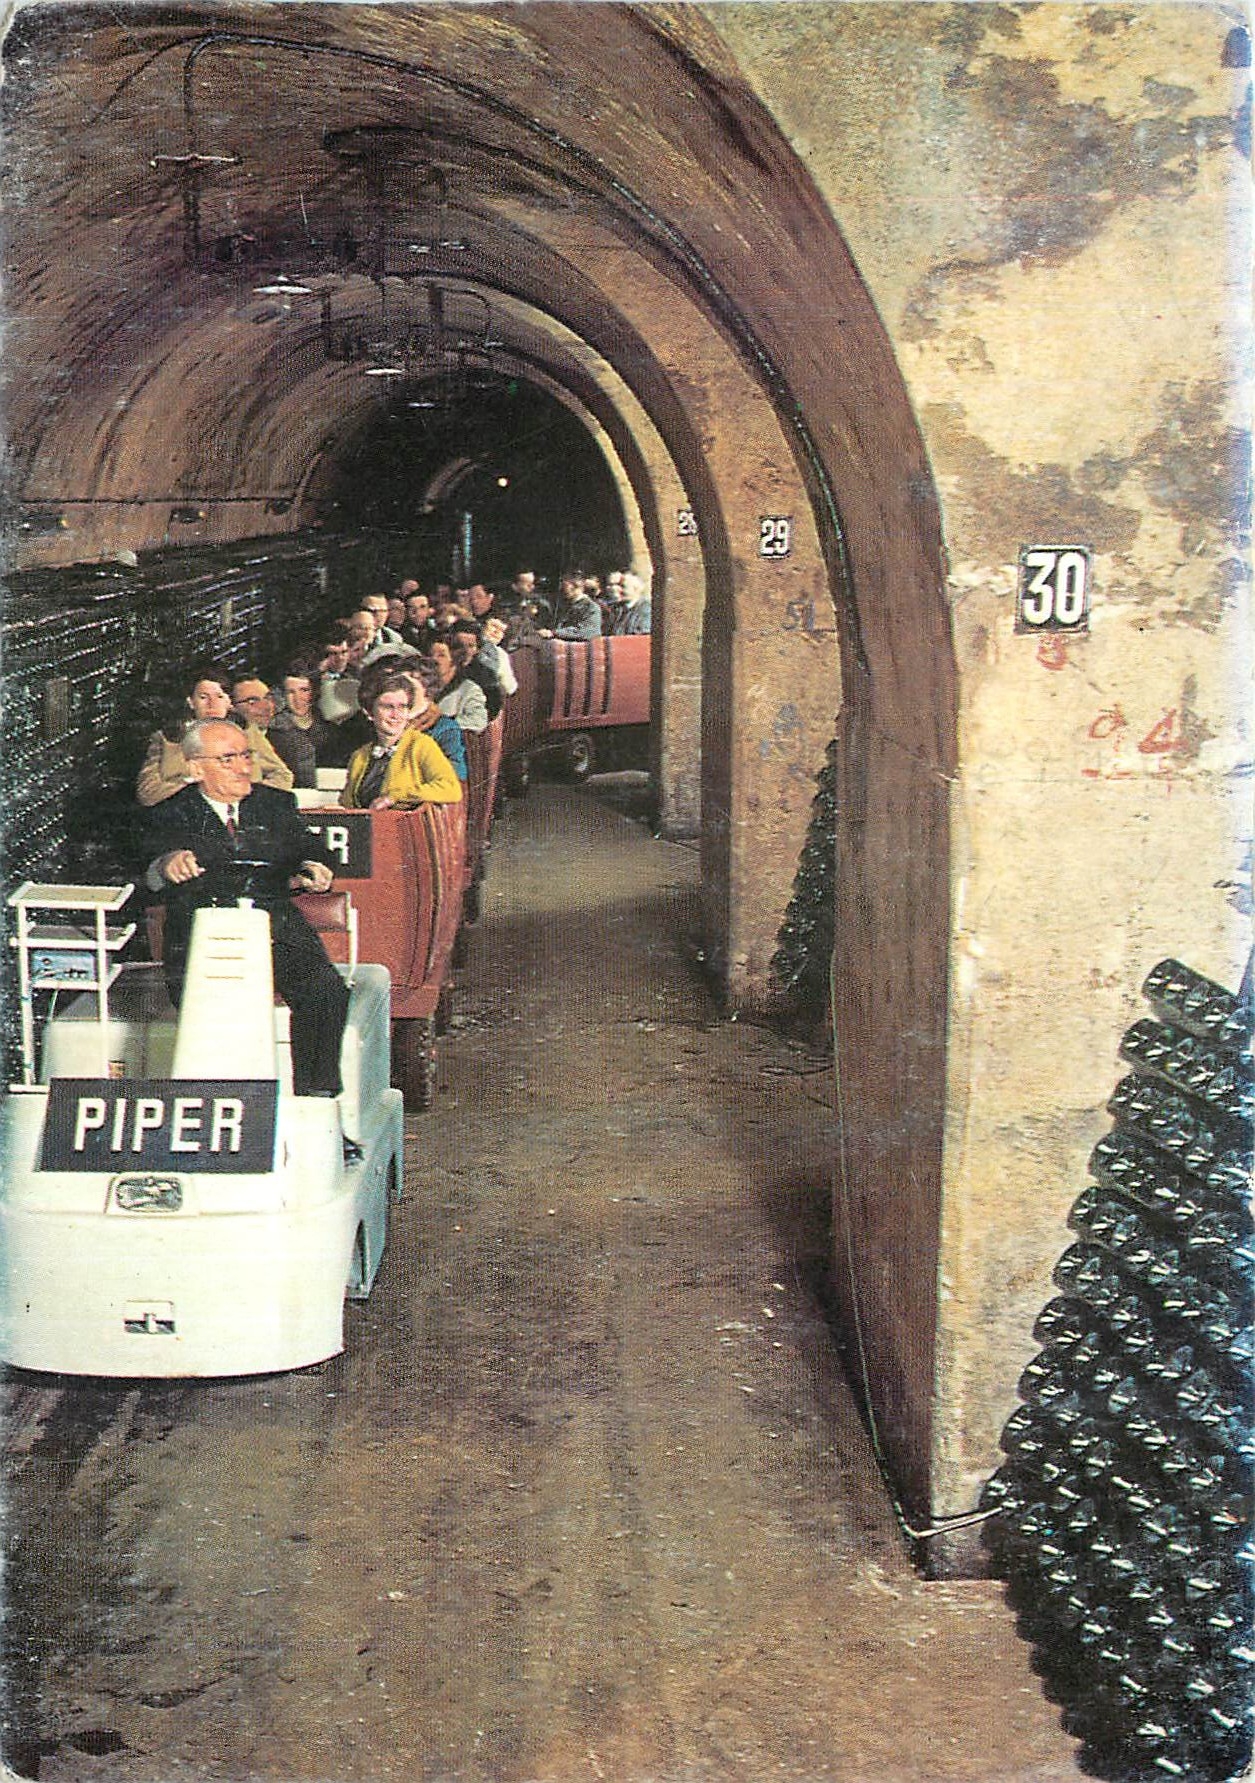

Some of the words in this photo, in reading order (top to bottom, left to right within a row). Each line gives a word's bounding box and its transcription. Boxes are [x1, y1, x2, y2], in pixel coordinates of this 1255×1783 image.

[760, 519, 790, 554] 29
[1021, 551, 1087, 625] 30
[74, 1097, 244, 1152] PIPER
